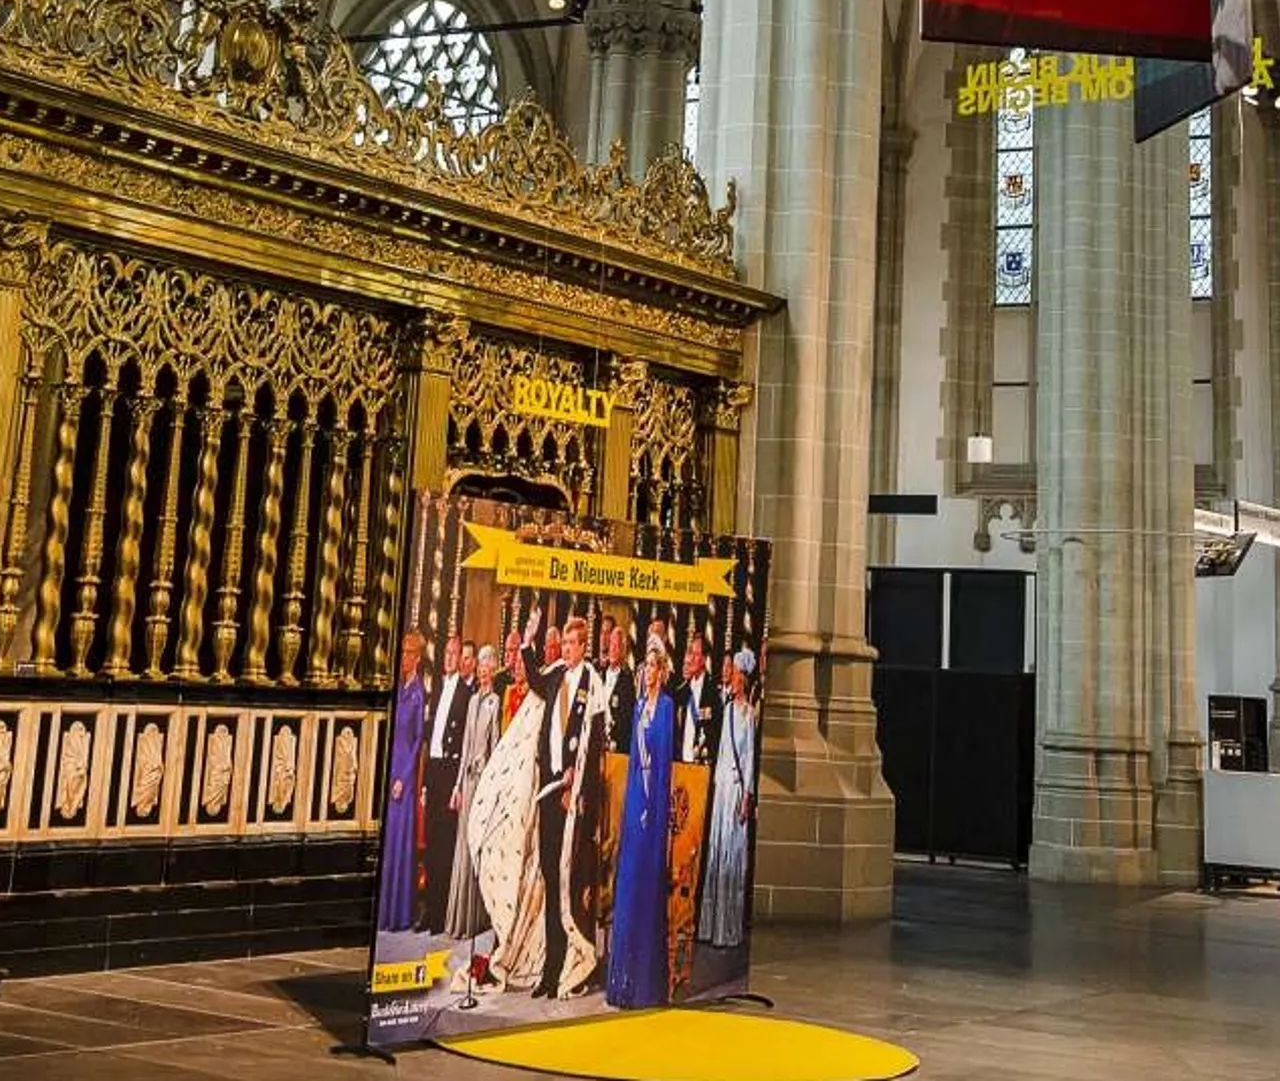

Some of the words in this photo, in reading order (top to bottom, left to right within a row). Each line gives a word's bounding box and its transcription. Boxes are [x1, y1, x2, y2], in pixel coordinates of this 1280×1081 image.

[513, 373, 616, 428] ROYALTY
[550, 557, 568, 580] De
[573, 559, 625, 588] Nieuwe
[629, 566, 660, 592] Kerk
